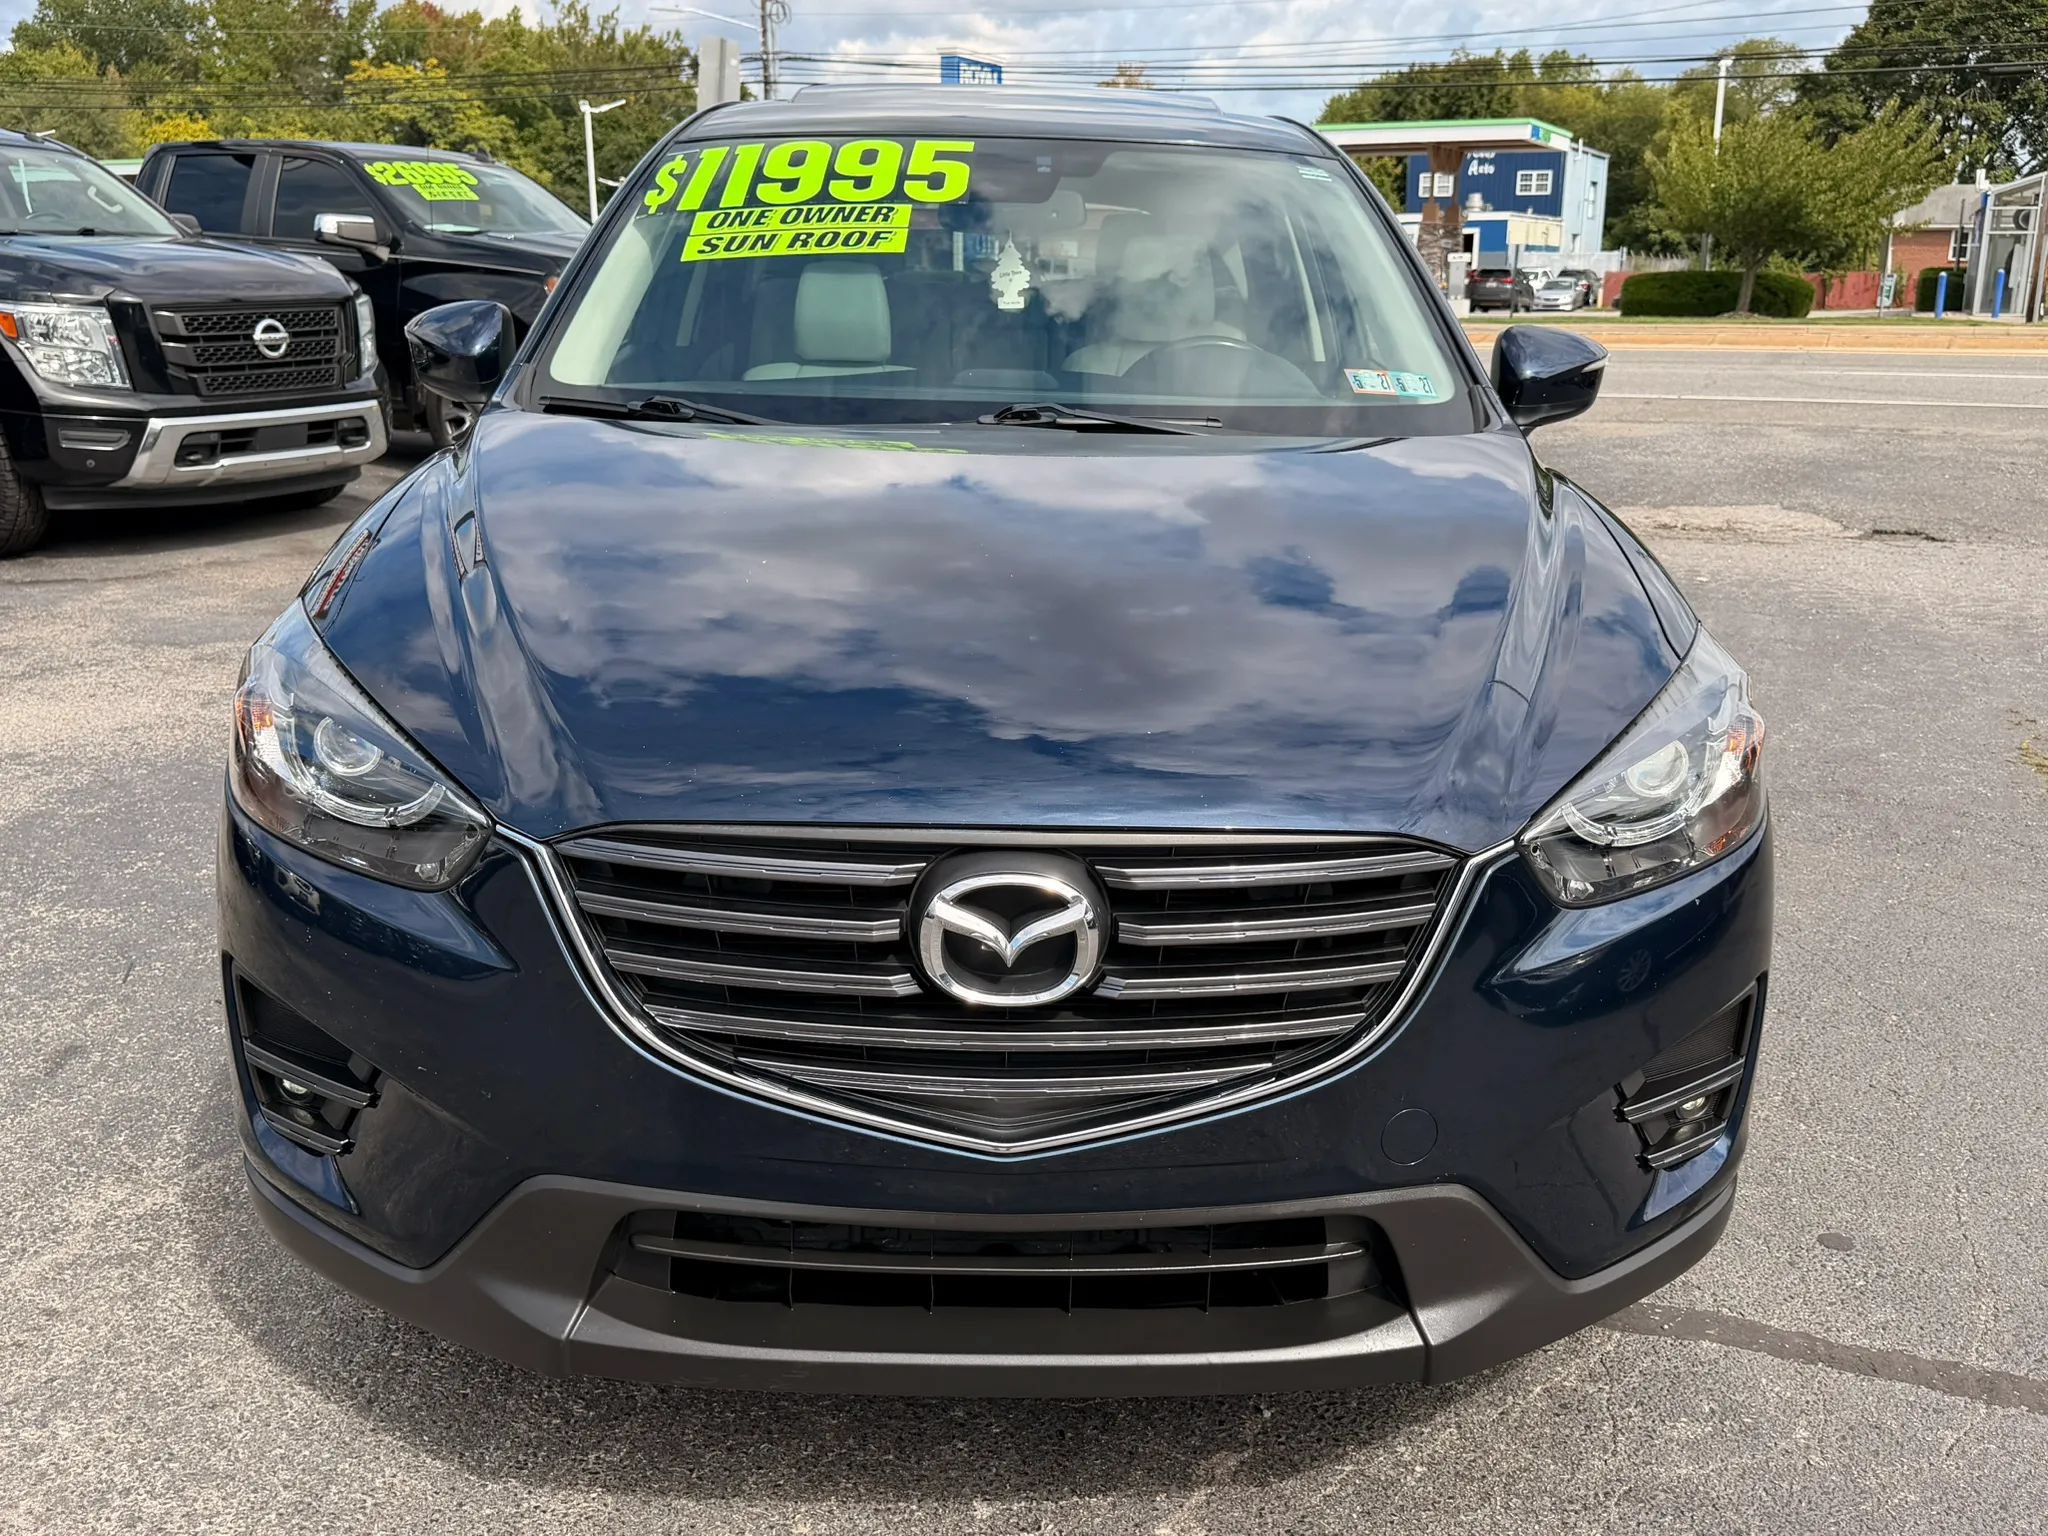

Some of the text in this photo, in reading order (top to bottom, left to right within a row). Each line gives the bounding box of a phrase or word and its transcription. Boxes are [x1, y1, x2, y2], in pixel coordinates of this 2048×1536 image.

[363, 161, 479, 186] $26995
[643, 139, 976, 215] $11995
[1467, 159, 1496, 176] Auto
[706, 205, 897, 231] ONE OWNER
[696, 230, 896, 256] SUN ROOF
